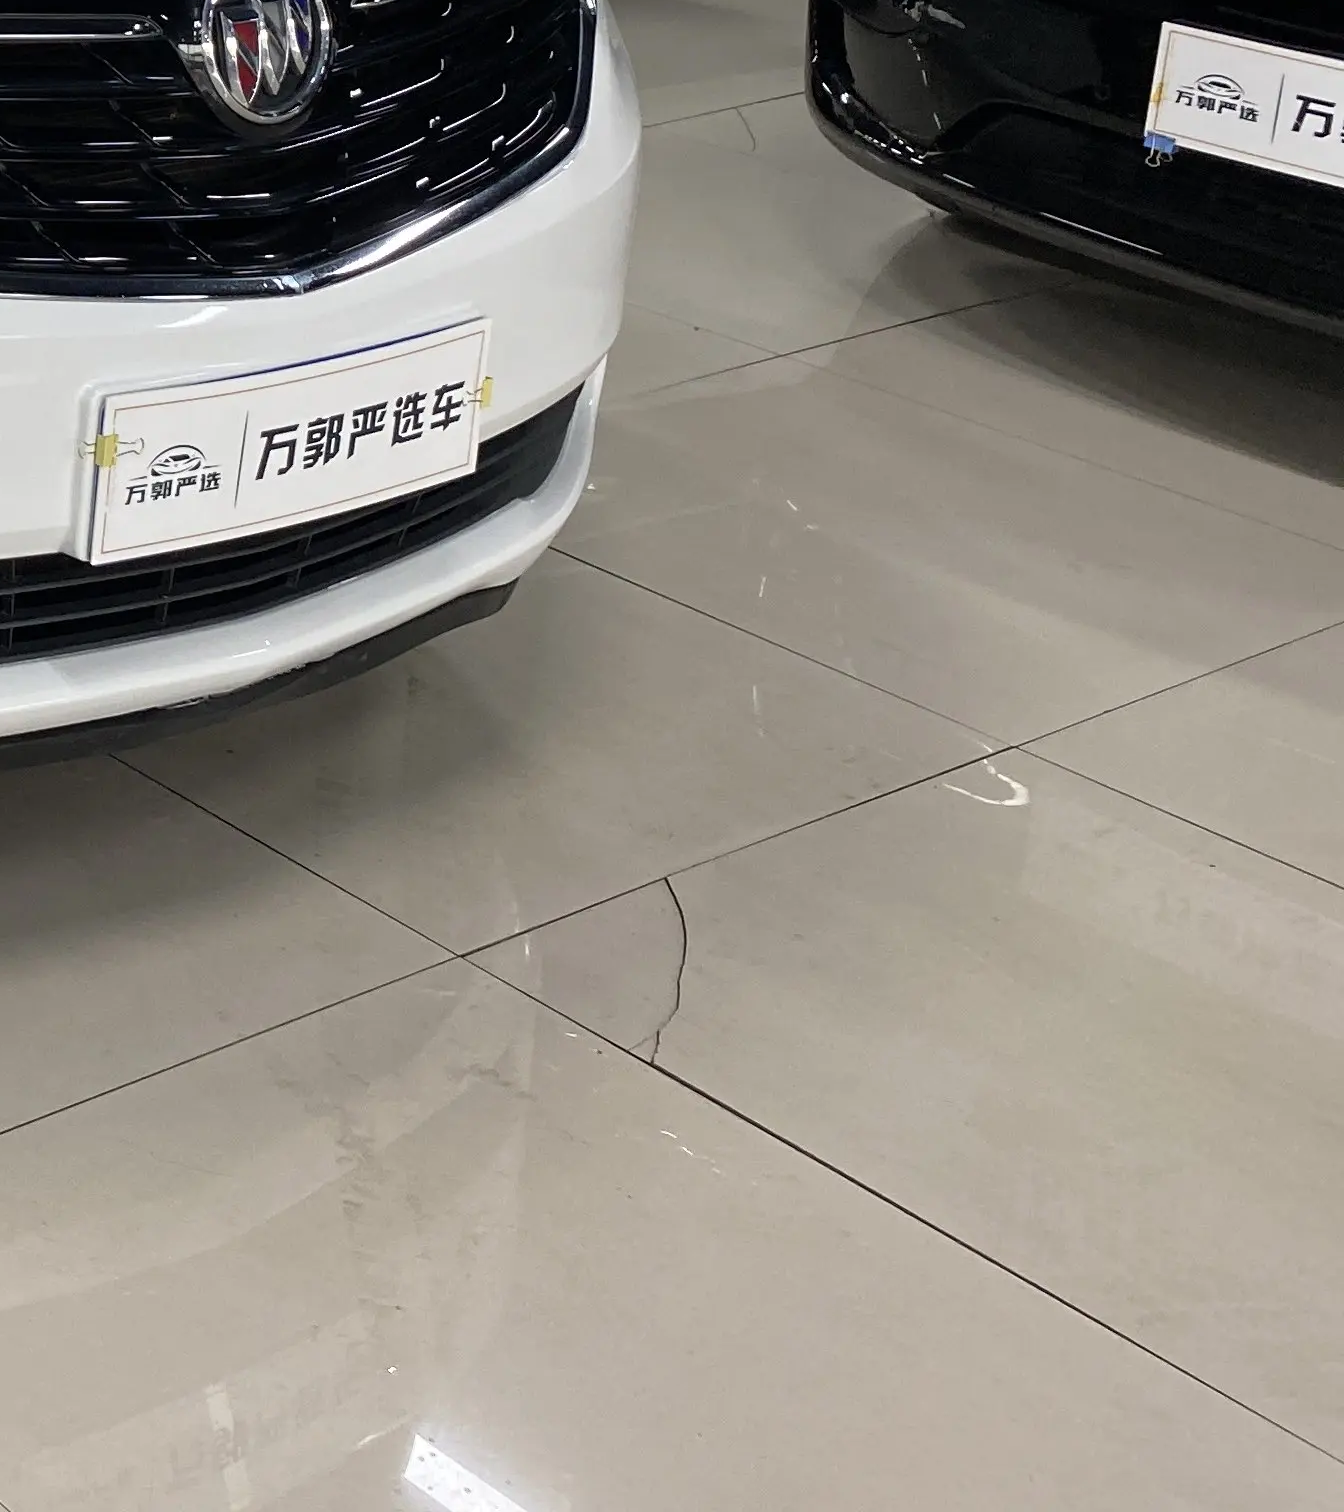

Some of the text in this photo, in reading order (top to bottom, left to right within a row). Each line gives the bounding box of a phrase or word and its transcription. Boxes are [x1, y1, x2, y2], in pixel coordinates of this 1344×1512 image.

[1175, 89, 1261, 123] 万郭严选
[1291, 94, 1344, 144] 万
[255, 380, 466, 481] 万郭严选车
[124, 471, 223, 506] 万郭严选
